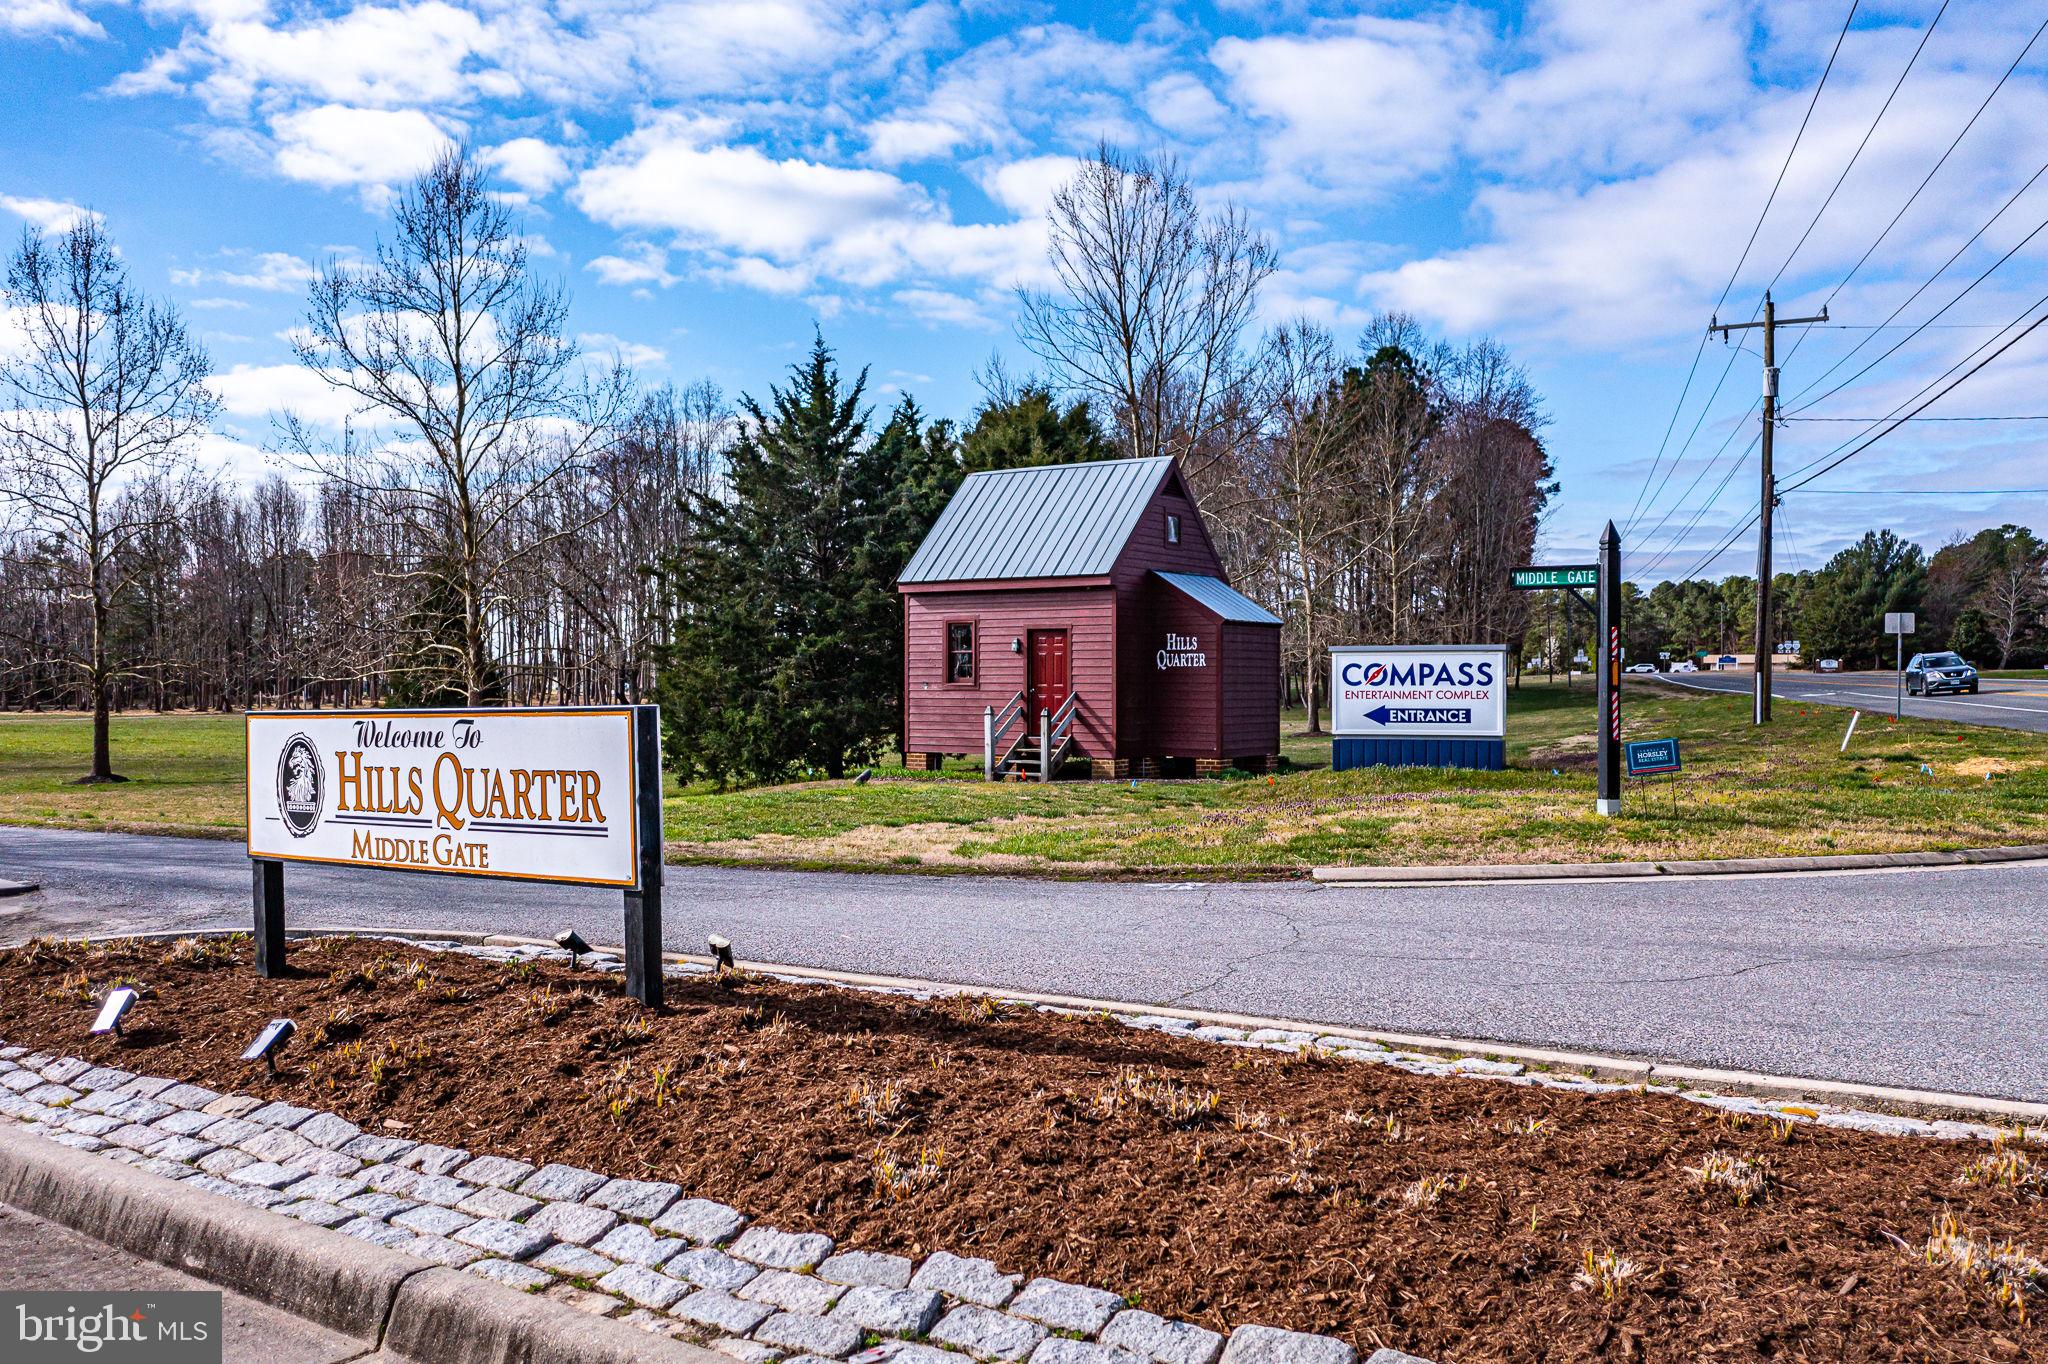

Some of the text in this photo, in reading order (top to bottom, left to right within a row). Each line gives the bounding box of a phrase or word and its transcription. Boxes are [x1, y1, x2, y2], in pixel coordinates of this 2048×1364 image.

[1516, 570, 1596, 585] MIDDLE GATE
[1166, 633, 1198, 650] HILLS
[1156, 650, 1206, 670] QUARTER
[1342, 662, 1493, 687] COMPASS
[1345, 690, 1489, 700] ENTERTAINMENT COMPLEX
[1389, 710, 1467, 722] ENTRANCE
[353, 719, 484, 749] Welcome To
[1637, 750, 1668, 759] HORSLEY
[335, 751, 606, 830] HILLS QUARTER
[351, 828, 489, 868] MIDDLE GATE
